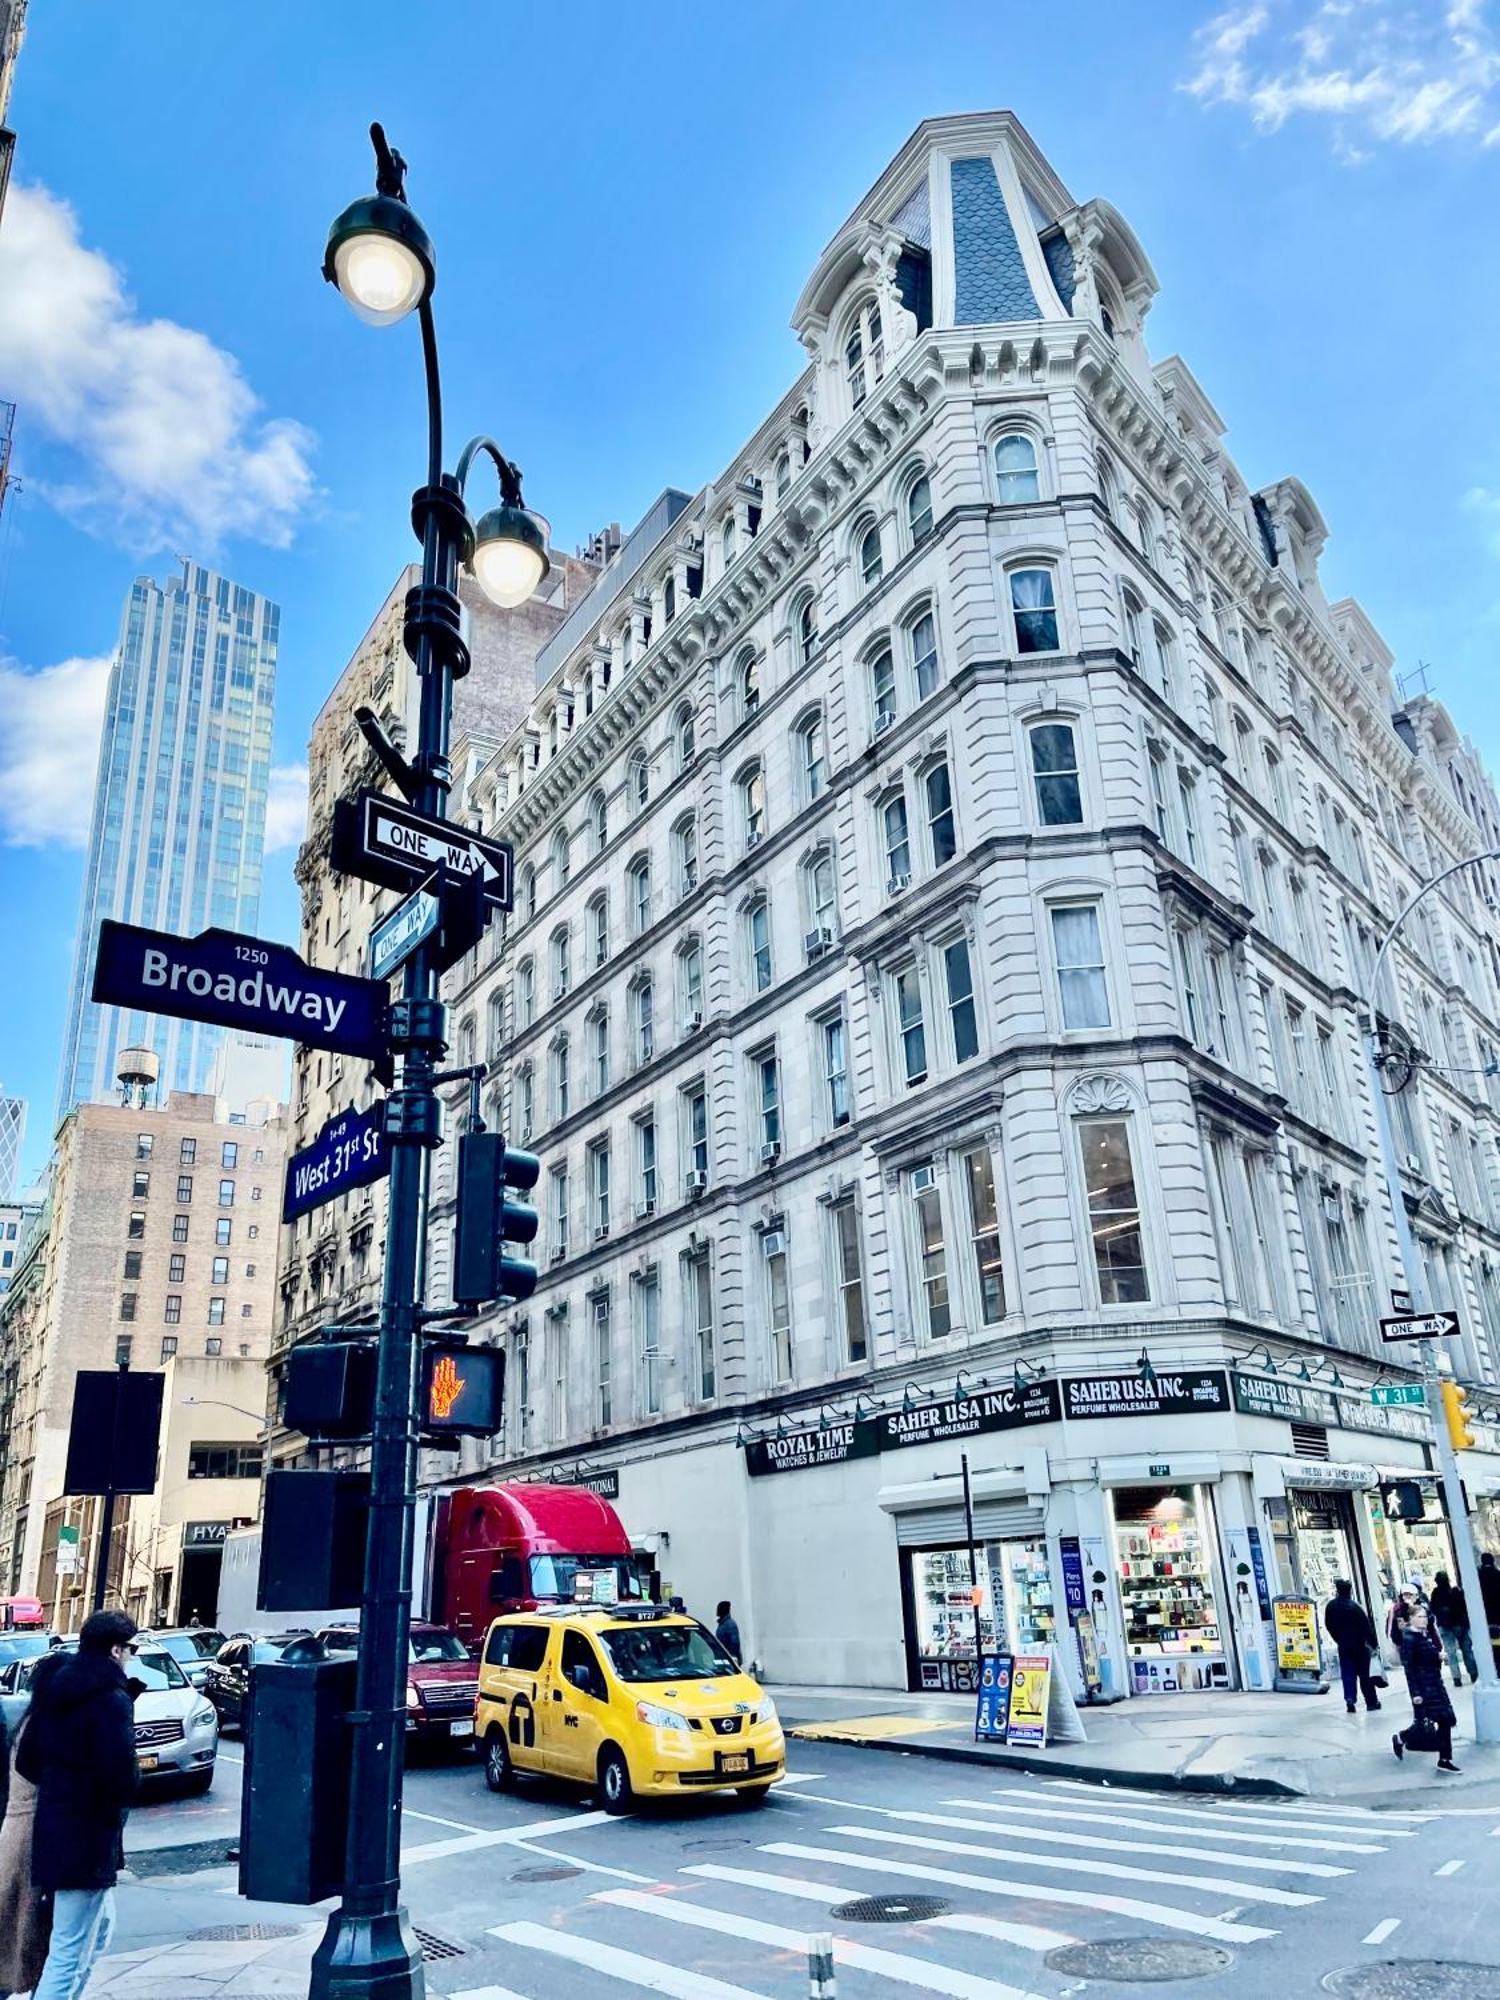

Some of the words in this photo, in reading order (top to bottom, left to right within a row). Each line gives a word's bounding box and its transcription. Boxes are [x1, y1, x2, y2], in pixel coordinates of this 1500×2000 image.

[390, 825, 428, 857] ONE
[447, 847, 487, 875] WAY
[380, 927, 398, 959] ONE
[408, 899, 428, 934] WAY
[234, 946, 269, 965] 1250
[142, 949, 346, 1033] Broadway
[295, 1155, 330, 1198] West
[333, 1134, 359, 1178] 31st
[363, 1127, 379, 1161] St
[1391, 1324, 1413, 1334] ONE
[1423, 1320, 1446, 1331] WAY
[1070, 1380, 1122, 1403] SAHER
[1124, 1378, 1156, 1400] USA
[1157, 1377, 1189, 1399] INC.
[1240, 1378, 1278, 1401] SAHER
[1279, 1384, 1301, 1406] USA
[1376, 1391, 1387, 1404] W
[1394, 1389, 1408, 1403] 31
[888, 1408, 940, 1434] SAHER
[945, 1399, 981, 1422] USA
[984, 1392, 1021, 1416] INC.
[1071, 1403, 1107, 1415] PERFUME
[1108, 1401, 1160, 1412] WHOLESALER
[766, 1435, 815, 1459] ROYAL
[816, 1426, 854, 1449] TIME
[899, 1428, 929, 1443] PERFUME
[933, 1420, 979, 1437] WHOLESALER
[776, 1453, 807, 1469] WATCHES
[809, 1452, 815, 1463] &
[816, 1446, 848, 1462] JEWELRY
[194, 1525, 231, 1539] HYA
[564, 1714, 578, 1728] NYC
